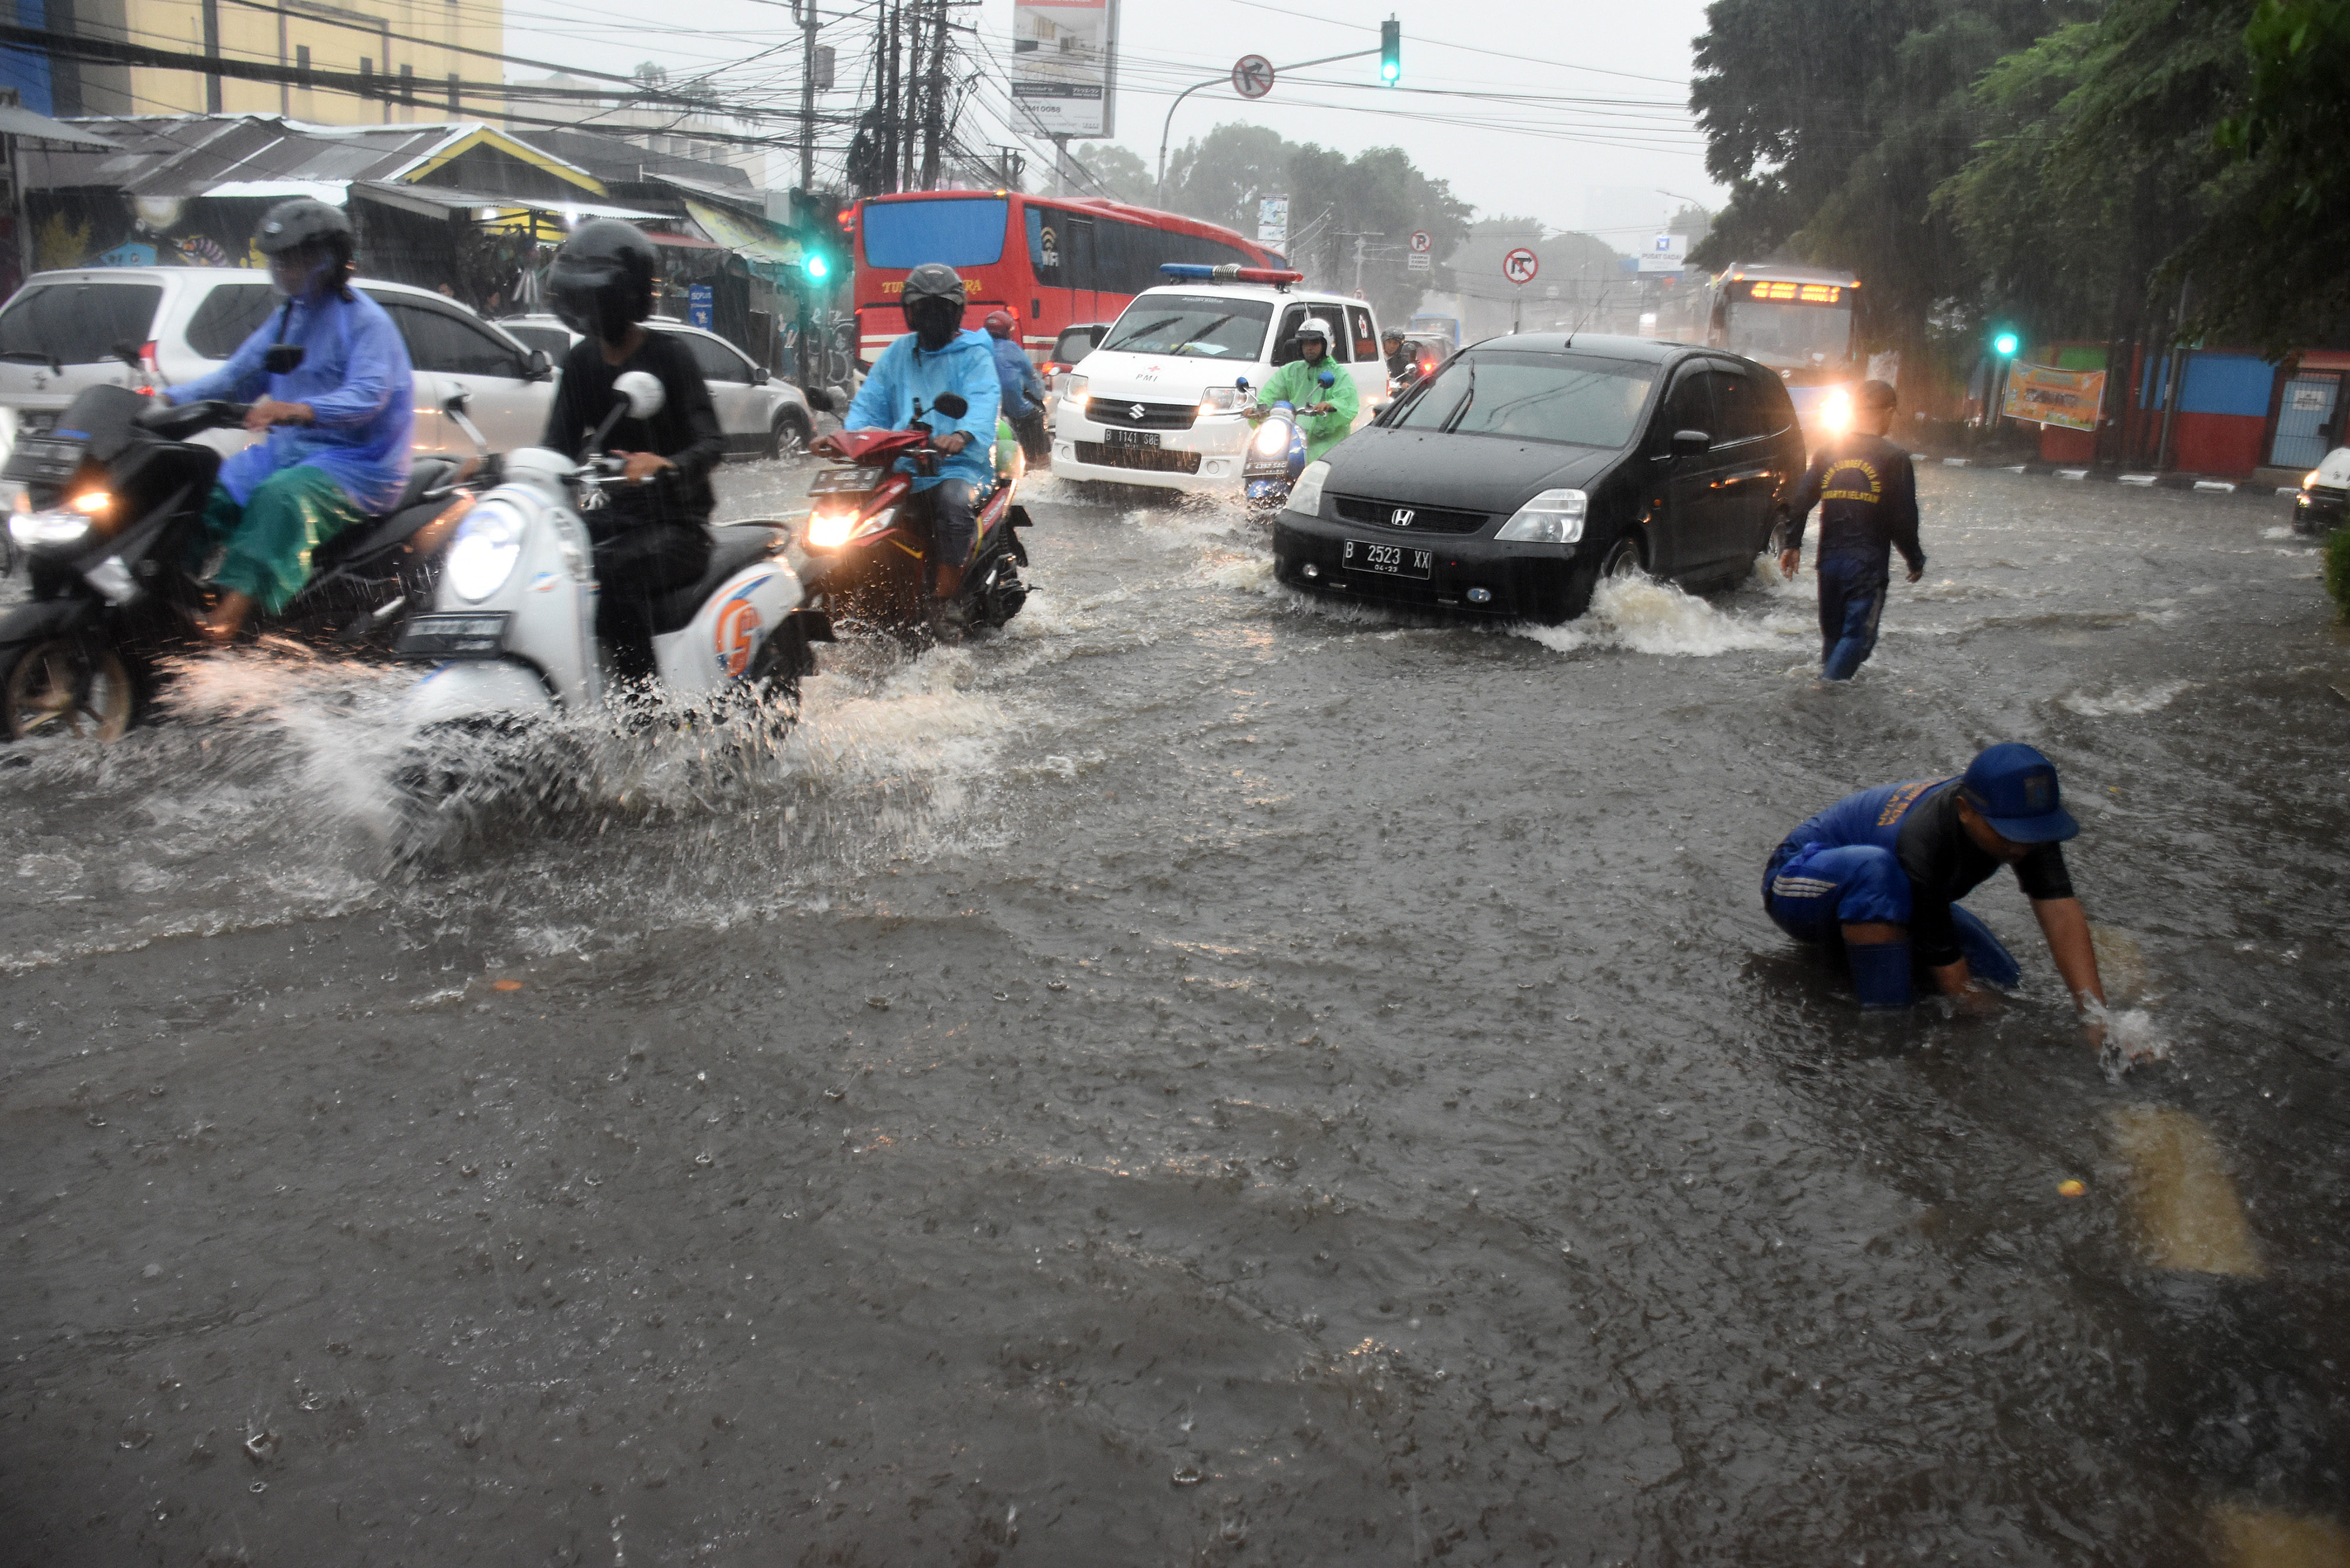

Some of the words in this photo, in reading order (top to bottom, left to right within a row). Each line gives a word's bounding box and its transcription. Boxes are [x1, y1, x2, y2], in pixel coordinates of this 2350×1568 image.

[1135, 374, 1158, 382] PMI
[1106, 429, 1112, 441] B
[1118, 431, 1137, 444] 1141
[1345, 542, 1354, 558] B
[1367, 545, 1401, 565] 2523
[1414, 550, 1429, 569] XX
